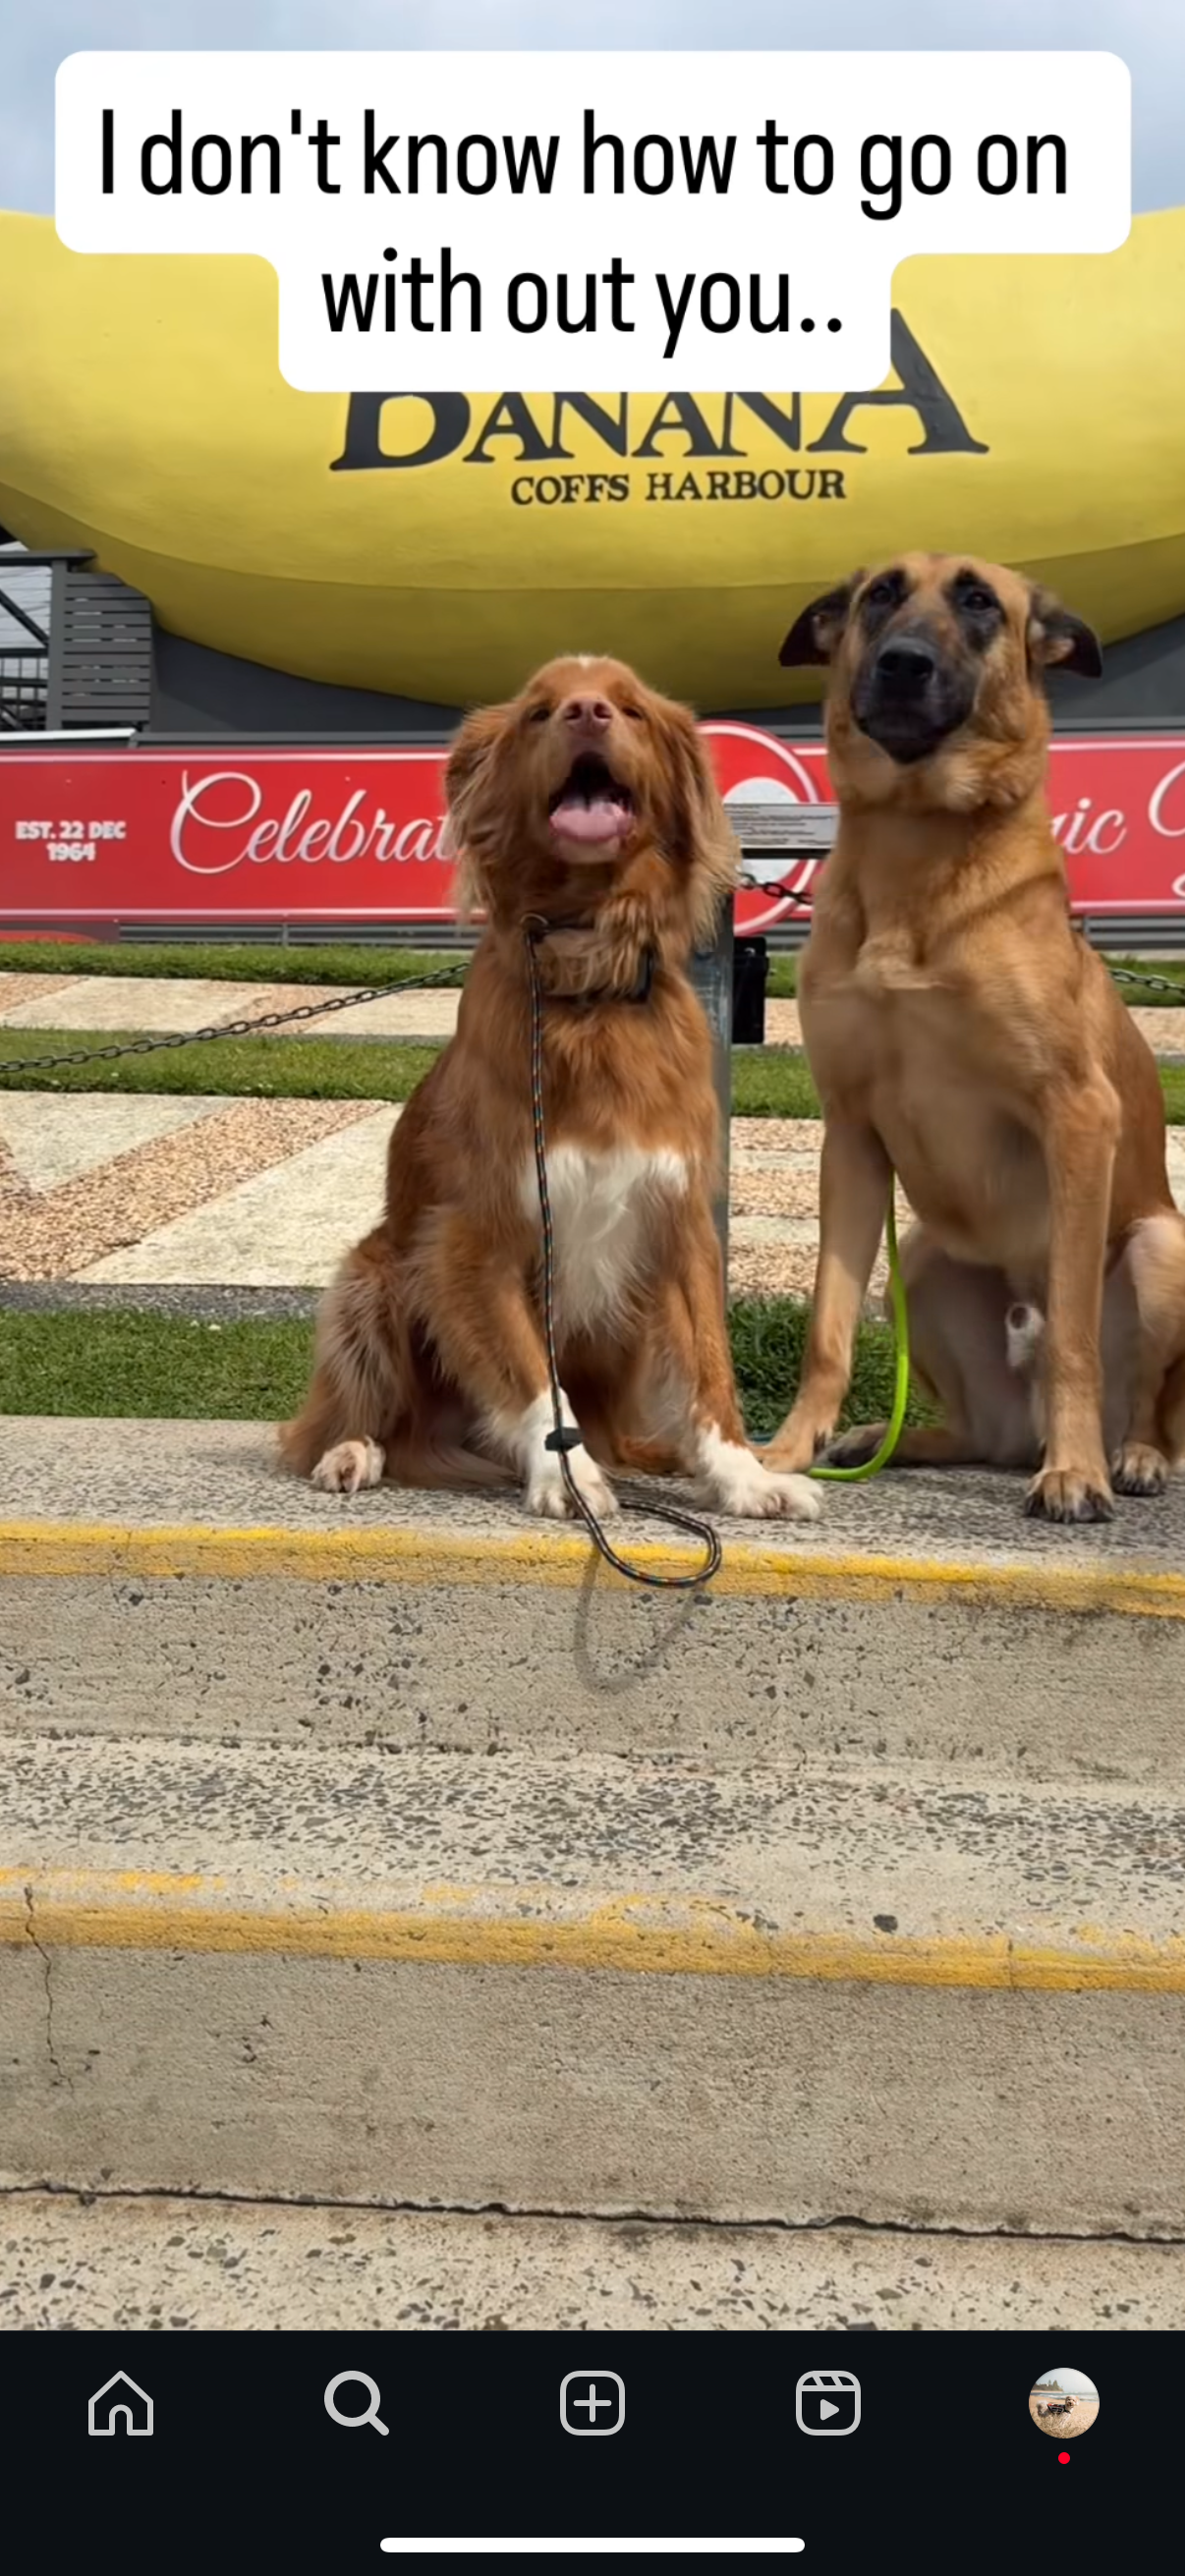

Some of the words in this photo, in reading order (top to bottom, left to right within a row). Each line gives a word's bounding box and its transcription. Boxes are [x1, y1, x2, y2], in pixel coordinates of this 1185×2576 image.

[511, 474, 629, 506] COFFS
[646, 470, 846, 501] HARBOUR
[15, 820, 56, 839] EST.
[59, 820, 85, 839] 22
[88, 820, 126, 839] DEC
[46, 842, 96, 861] 1964
